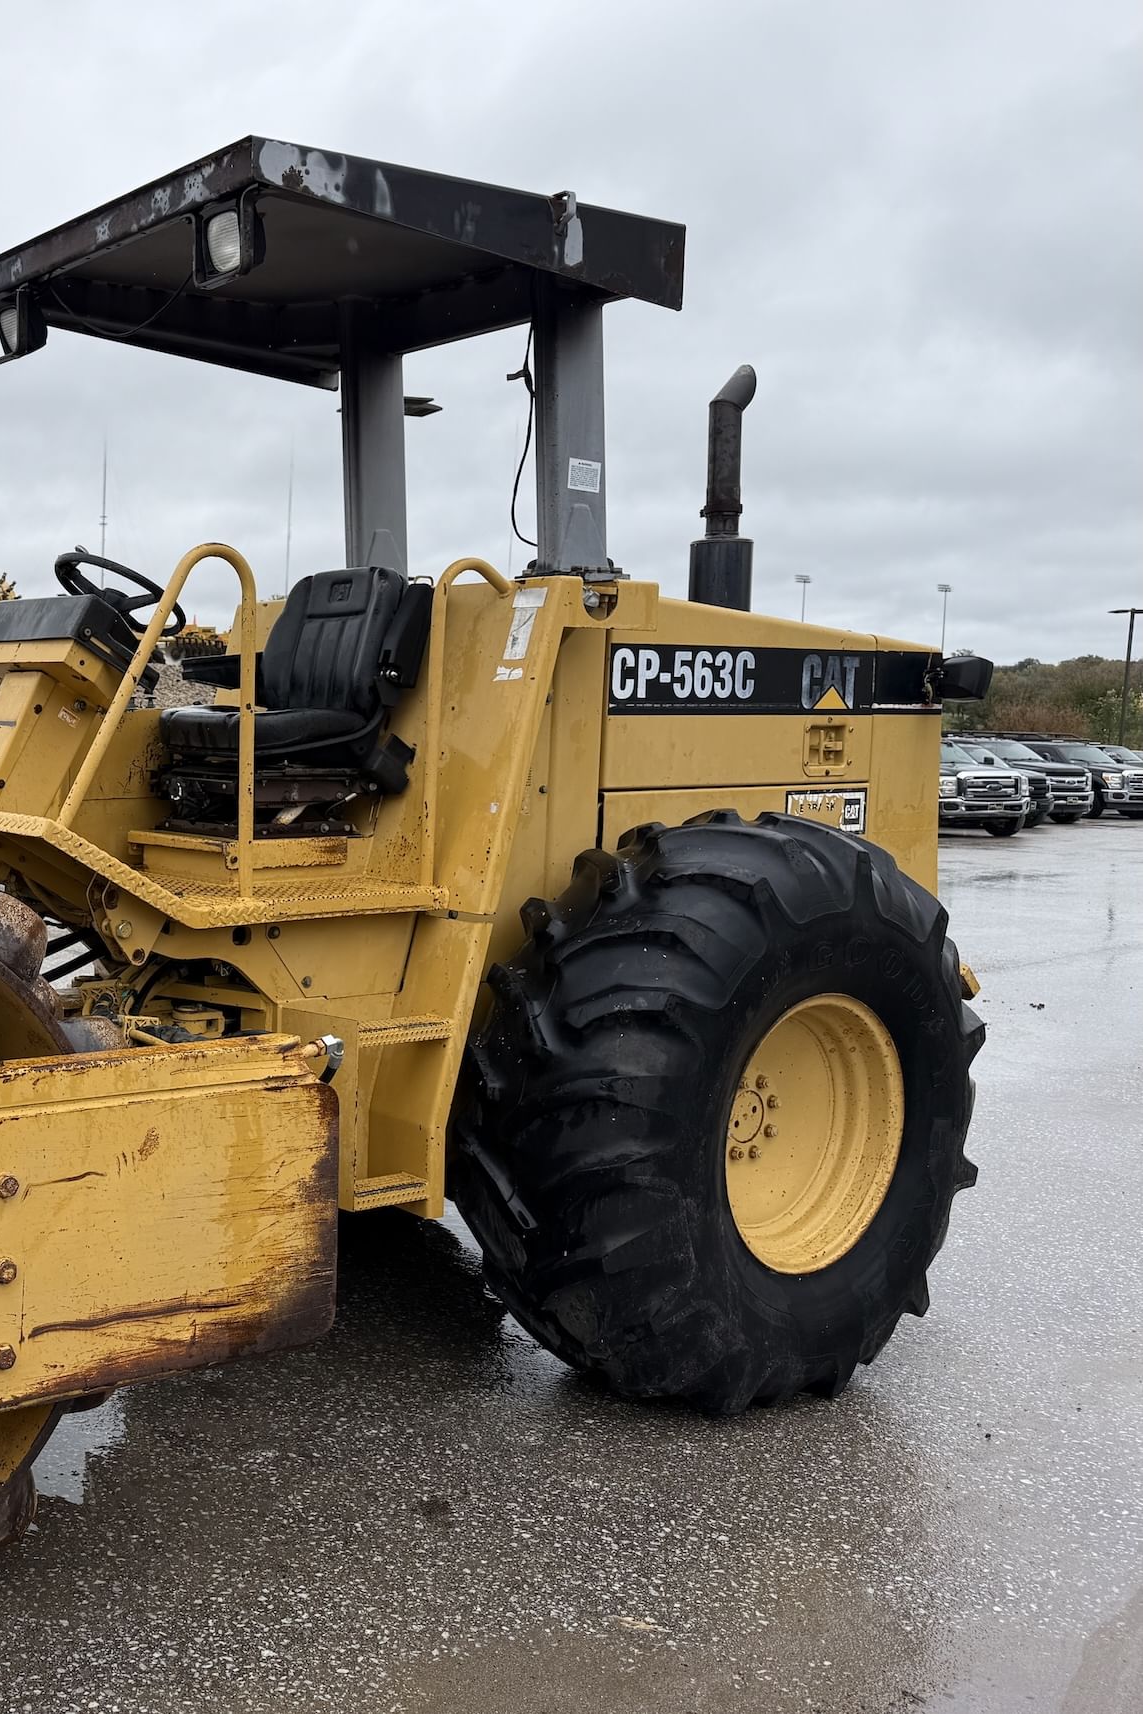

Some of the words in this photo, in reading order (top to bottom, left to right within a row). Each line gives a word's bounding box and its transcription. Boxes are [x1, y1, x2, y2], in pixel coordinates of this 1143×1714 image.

[611, 647, 756, 700] CP-563C
[800, 653, 860, 710] CAT
[845, 804, 860, 819] CAT
